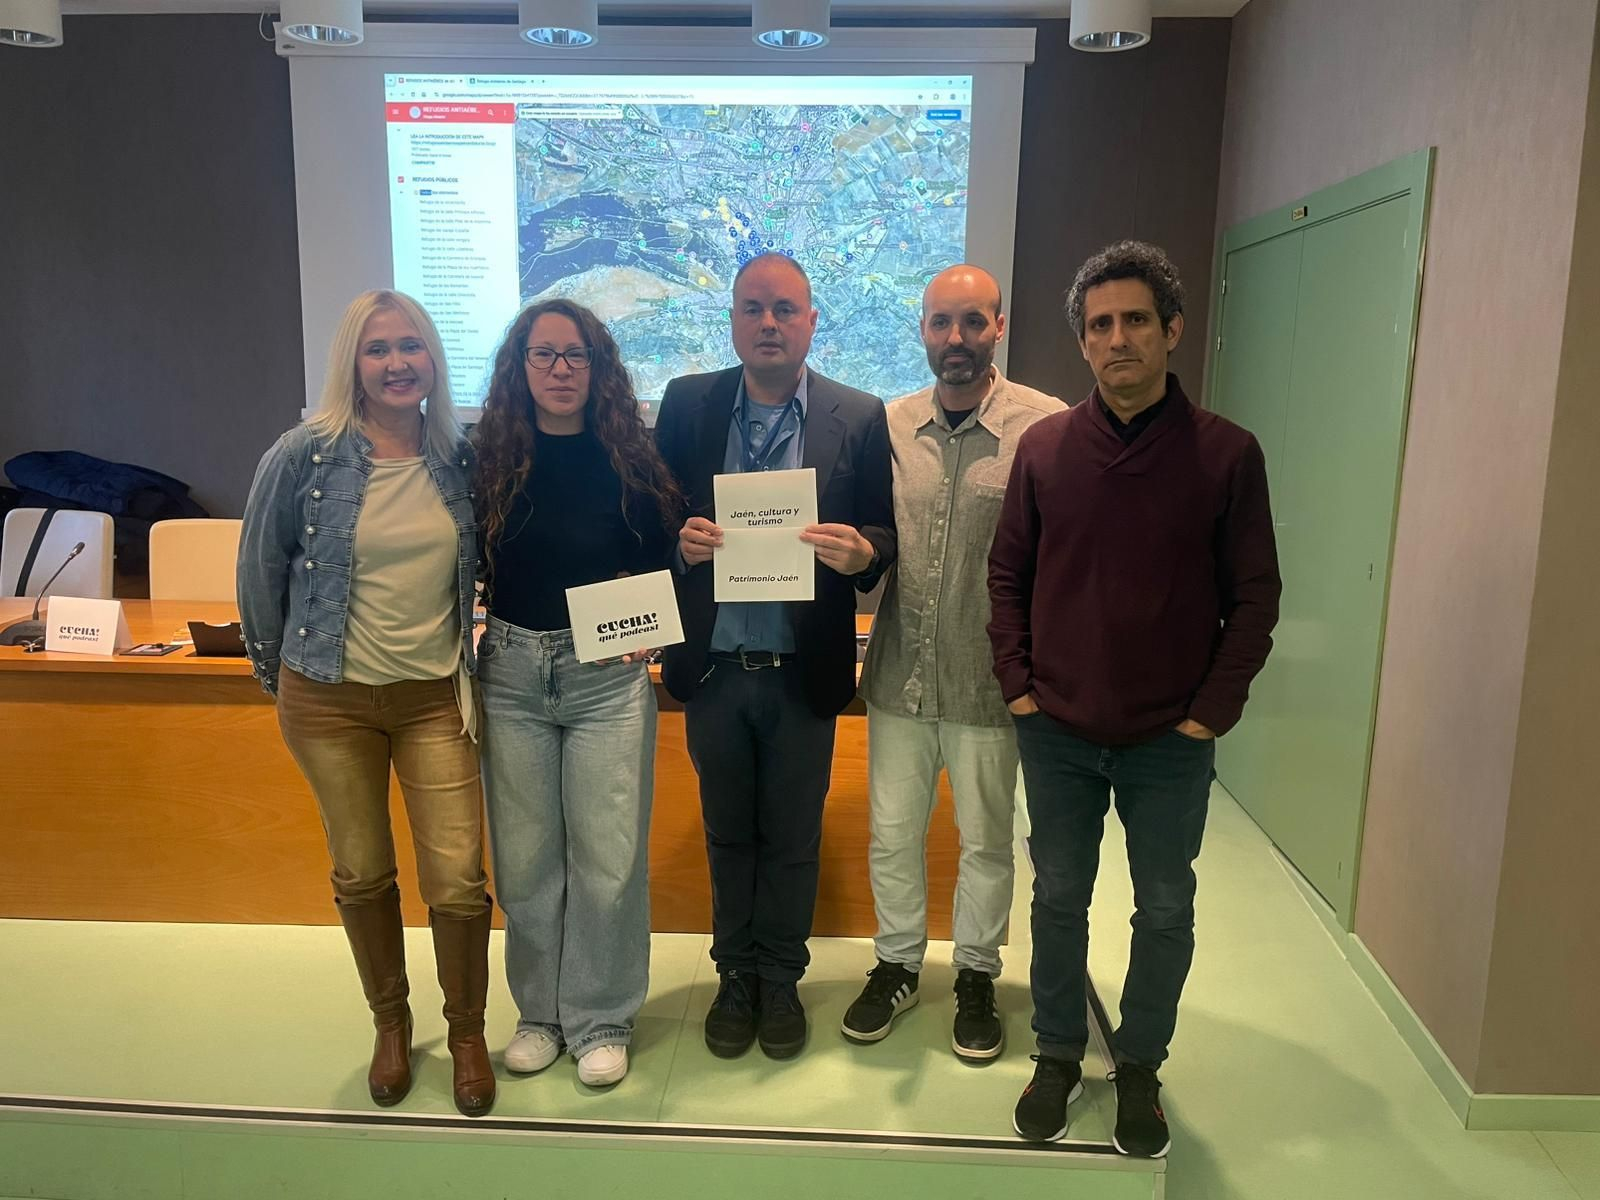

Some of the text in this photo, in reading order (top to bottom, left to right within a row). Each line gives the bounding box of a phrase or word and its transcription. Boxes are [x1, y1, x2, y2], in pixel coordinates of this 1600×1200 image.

[730, 508, 800, 518] Jaén, cultura y
[597, 613, 657, 633] CUCHA!
[60, 626, 100, 636] CUCHA!
[599, 624, 659, 642] qué podcast
